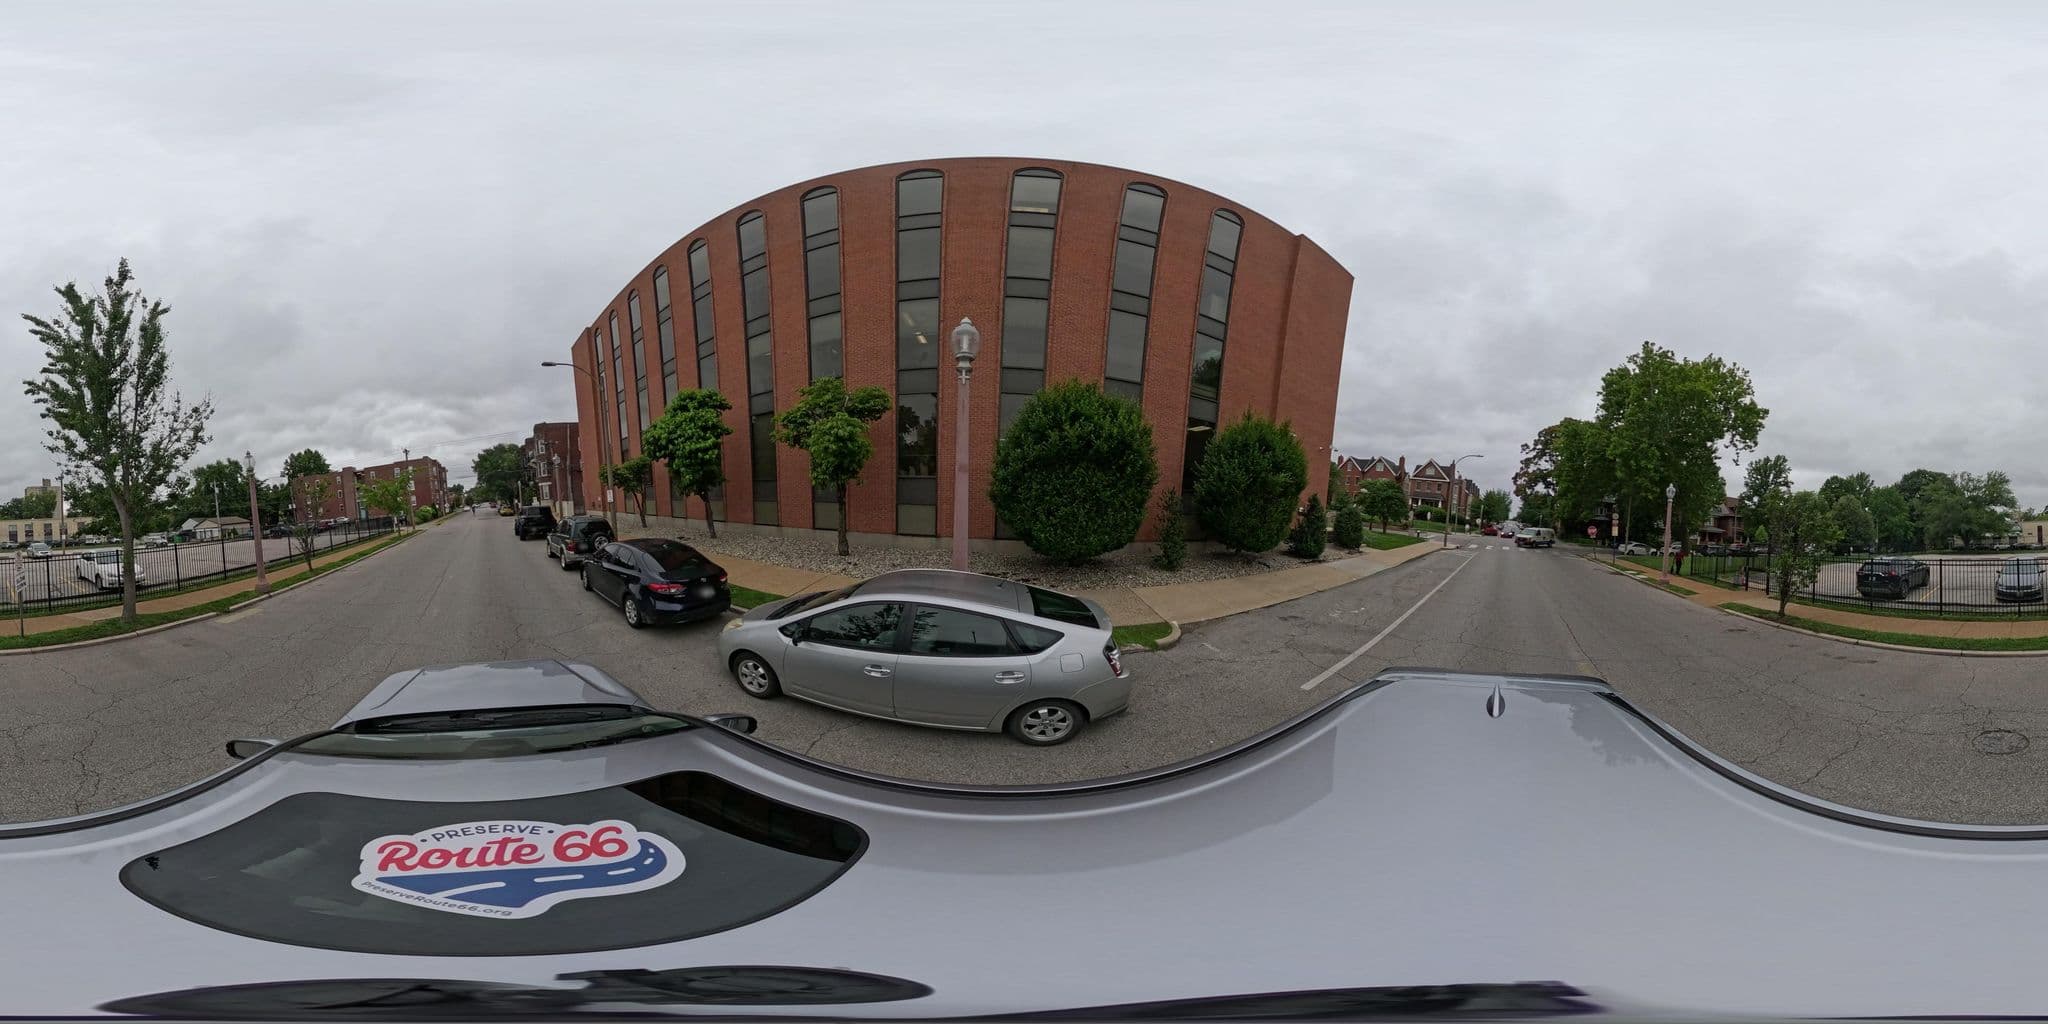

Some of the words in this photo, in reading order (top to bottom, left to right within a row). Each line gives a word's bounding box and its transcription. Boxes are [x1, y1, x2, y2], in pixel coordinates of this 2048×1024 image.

[377, 836, 545, 872] Route
[553, 826, 629, 862] 66
[432, 824, 543, 842] PRESERVE
[361, 881, 512, 916] PreserveRoute66.org
